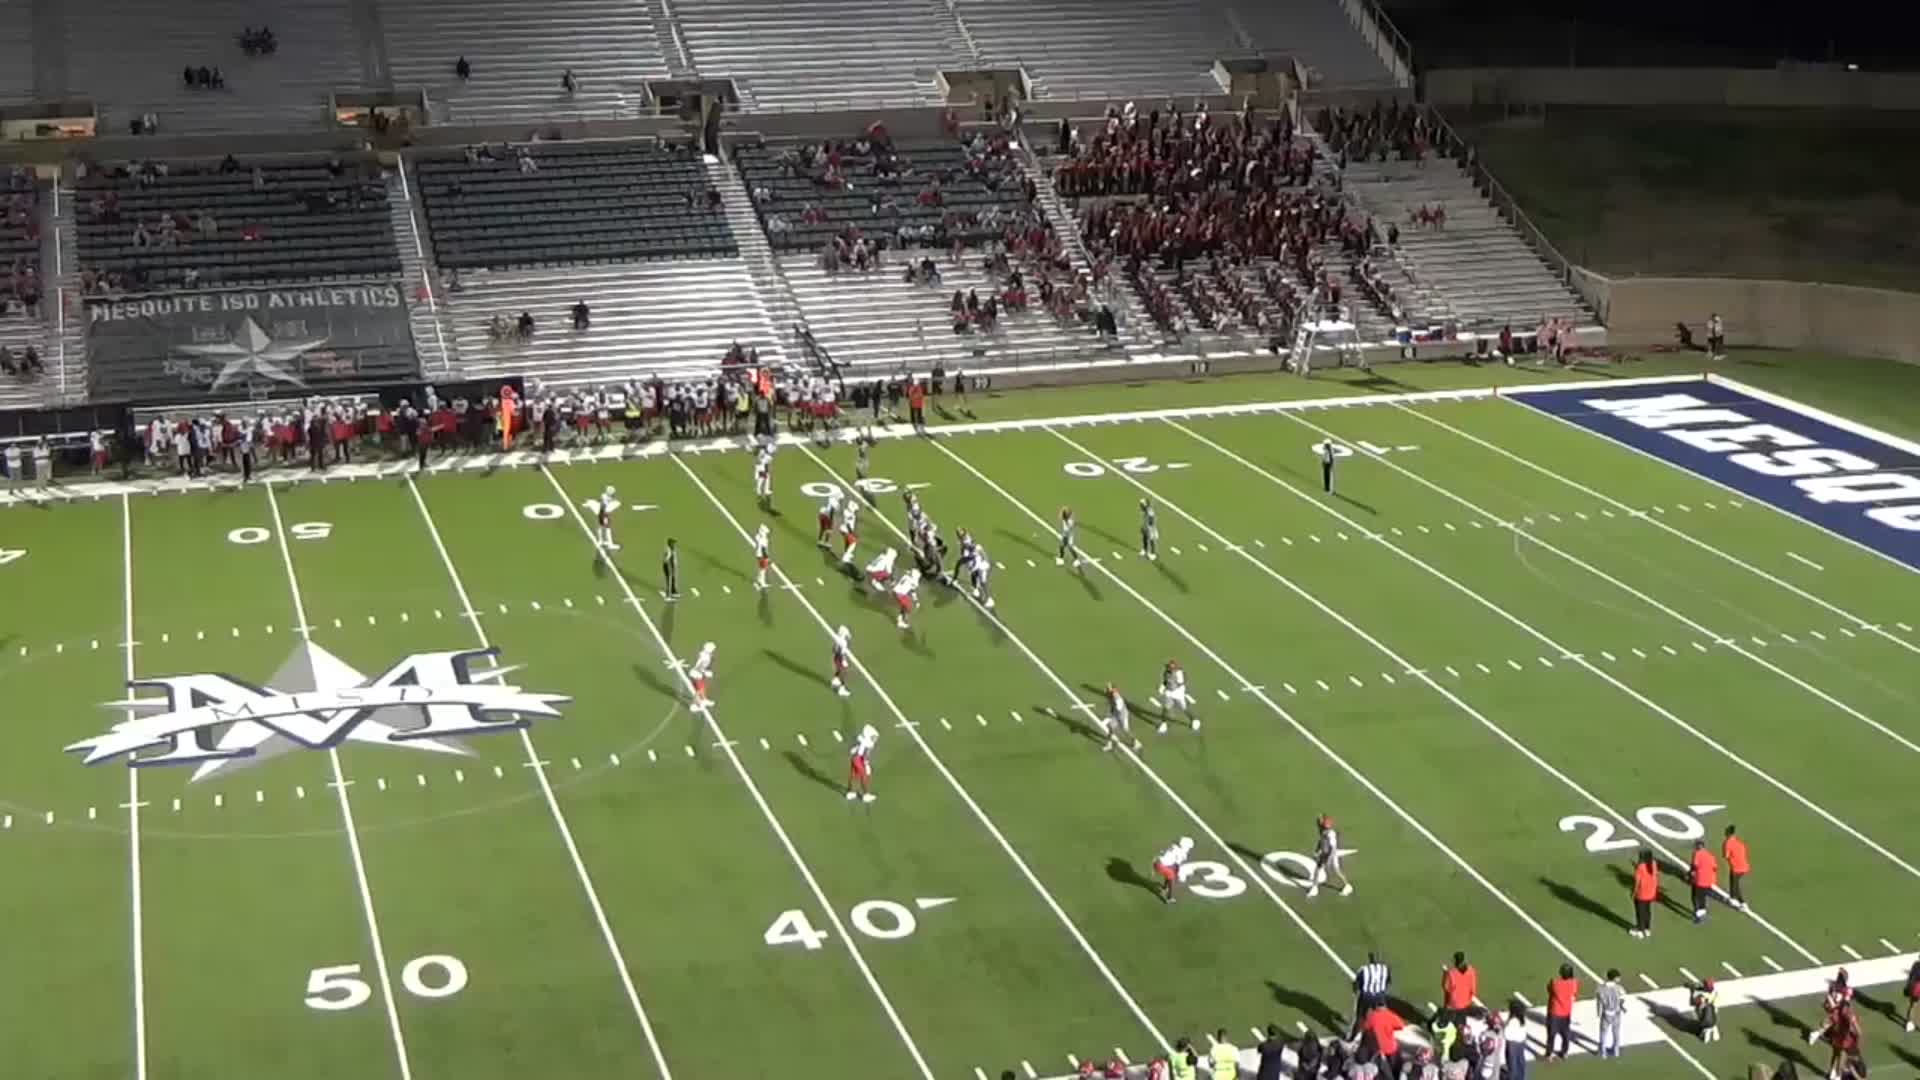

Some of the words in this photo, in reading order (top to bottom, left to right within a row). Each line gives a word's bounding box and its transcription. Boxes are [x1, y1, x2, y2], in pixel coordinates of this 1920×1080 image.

[91, 296, 212, 321] MESQUITE
[222, 291, 259, 312] ISD
[269, 286, 399, 308] ATHLETICS
[1064, 457, 1160, 477] 20
[227, 521, 333, 544] 50
[1558, 806, 1705, 853] 20
[1177, 851, 1327, 898] 30
[763, 900, 916, 950] 40
[304, 954, 468, 1010] 50
